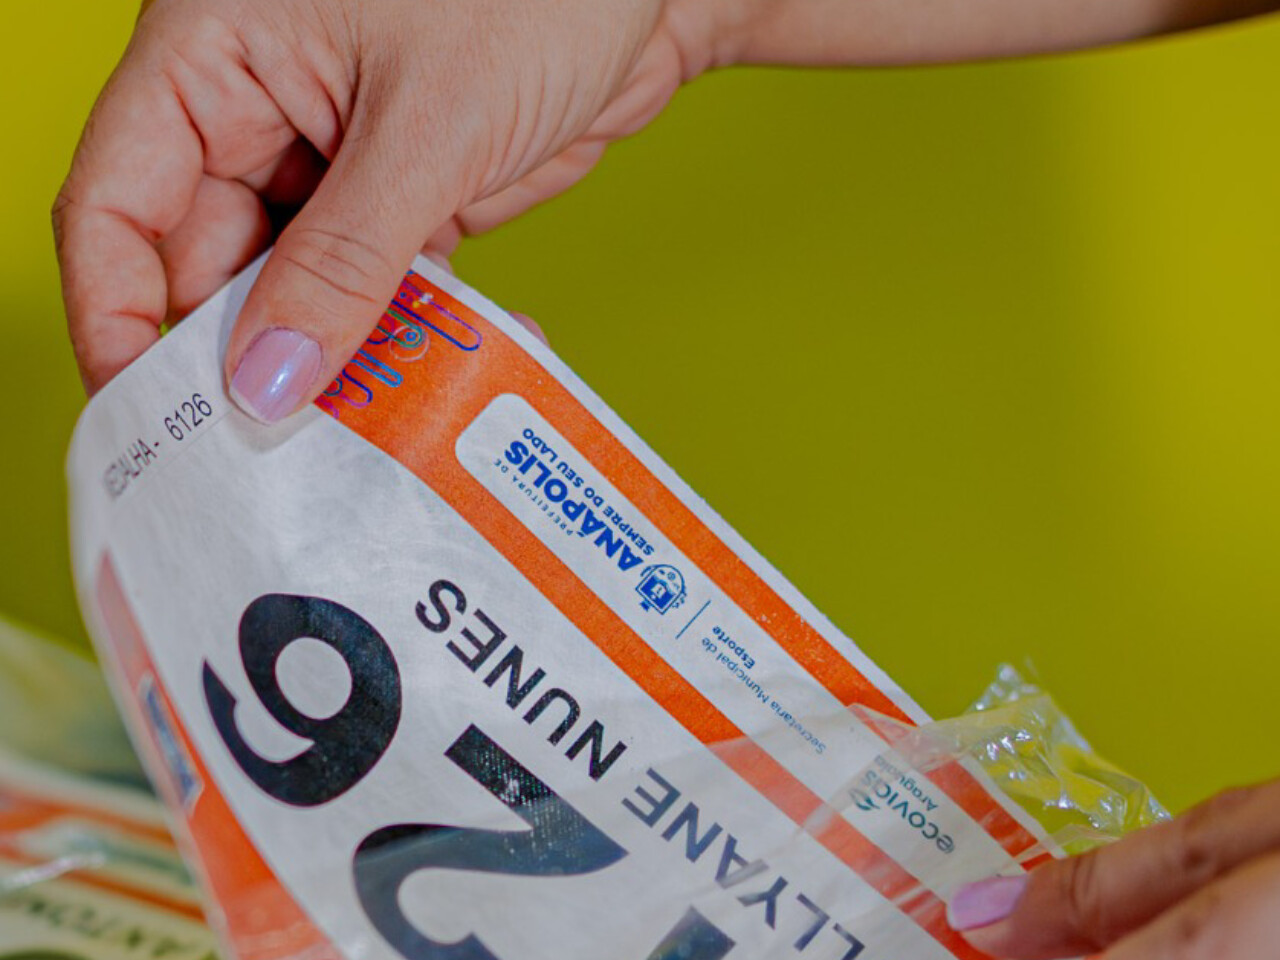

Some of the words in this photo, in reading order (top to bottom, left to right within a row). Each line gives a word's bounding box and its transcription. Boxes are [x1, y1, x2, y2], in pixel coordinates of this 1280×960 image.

[164, 392, 214, 442] 6126
[493, 458, 510, 474] DE
[522, 427, 559, 463] LADO
[556, 461, 585, 488] SEU
[583, 487, 606, 508] DO
[504, 440, 644, 572] ANÁPOLIS
[511, 475, 574, 536] PREFEITURA
[602, 505, 655, 556] SEMPRE
[701, 636, 718, 653] de
[711, 625, 756, 671] Esporte
[415, 579, 628, 782] NUNES
[716, 651, 770, 704] Municipal
[769, 700, 827, 755] Secretaria
